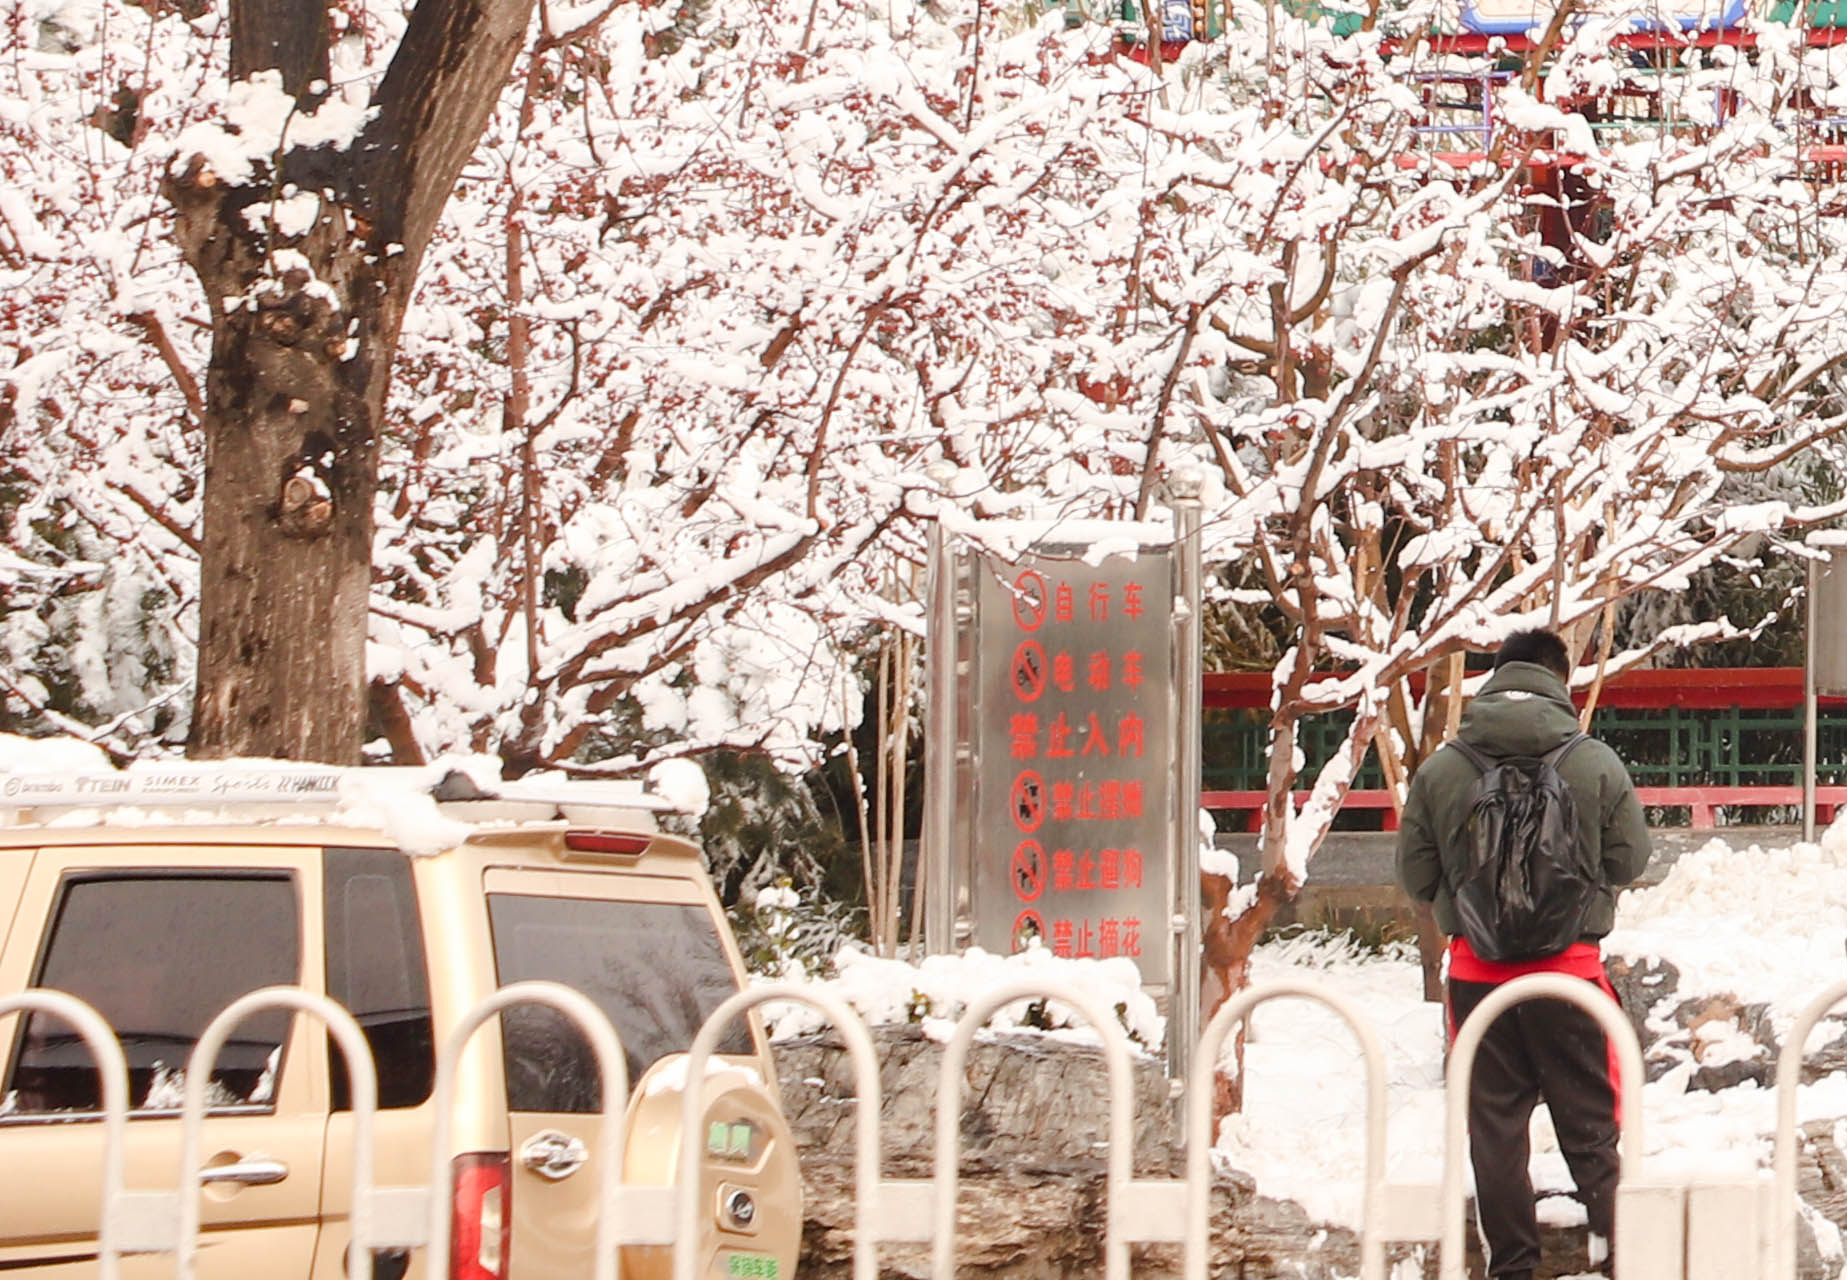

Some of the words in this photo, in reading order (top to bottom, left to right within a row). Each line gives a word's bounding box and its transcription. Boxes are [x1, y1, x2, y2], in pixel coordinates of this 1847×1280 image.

[1055, 581, 1144, 623] 自行车
[1053, 649, 1144, 691] 电动车
[1009, 710, 1144, 760] 禁止入内
[1053, 848, 1142, 891] 禁止遛狗
[1053, 916, 1141, 958] 禁止摘花
